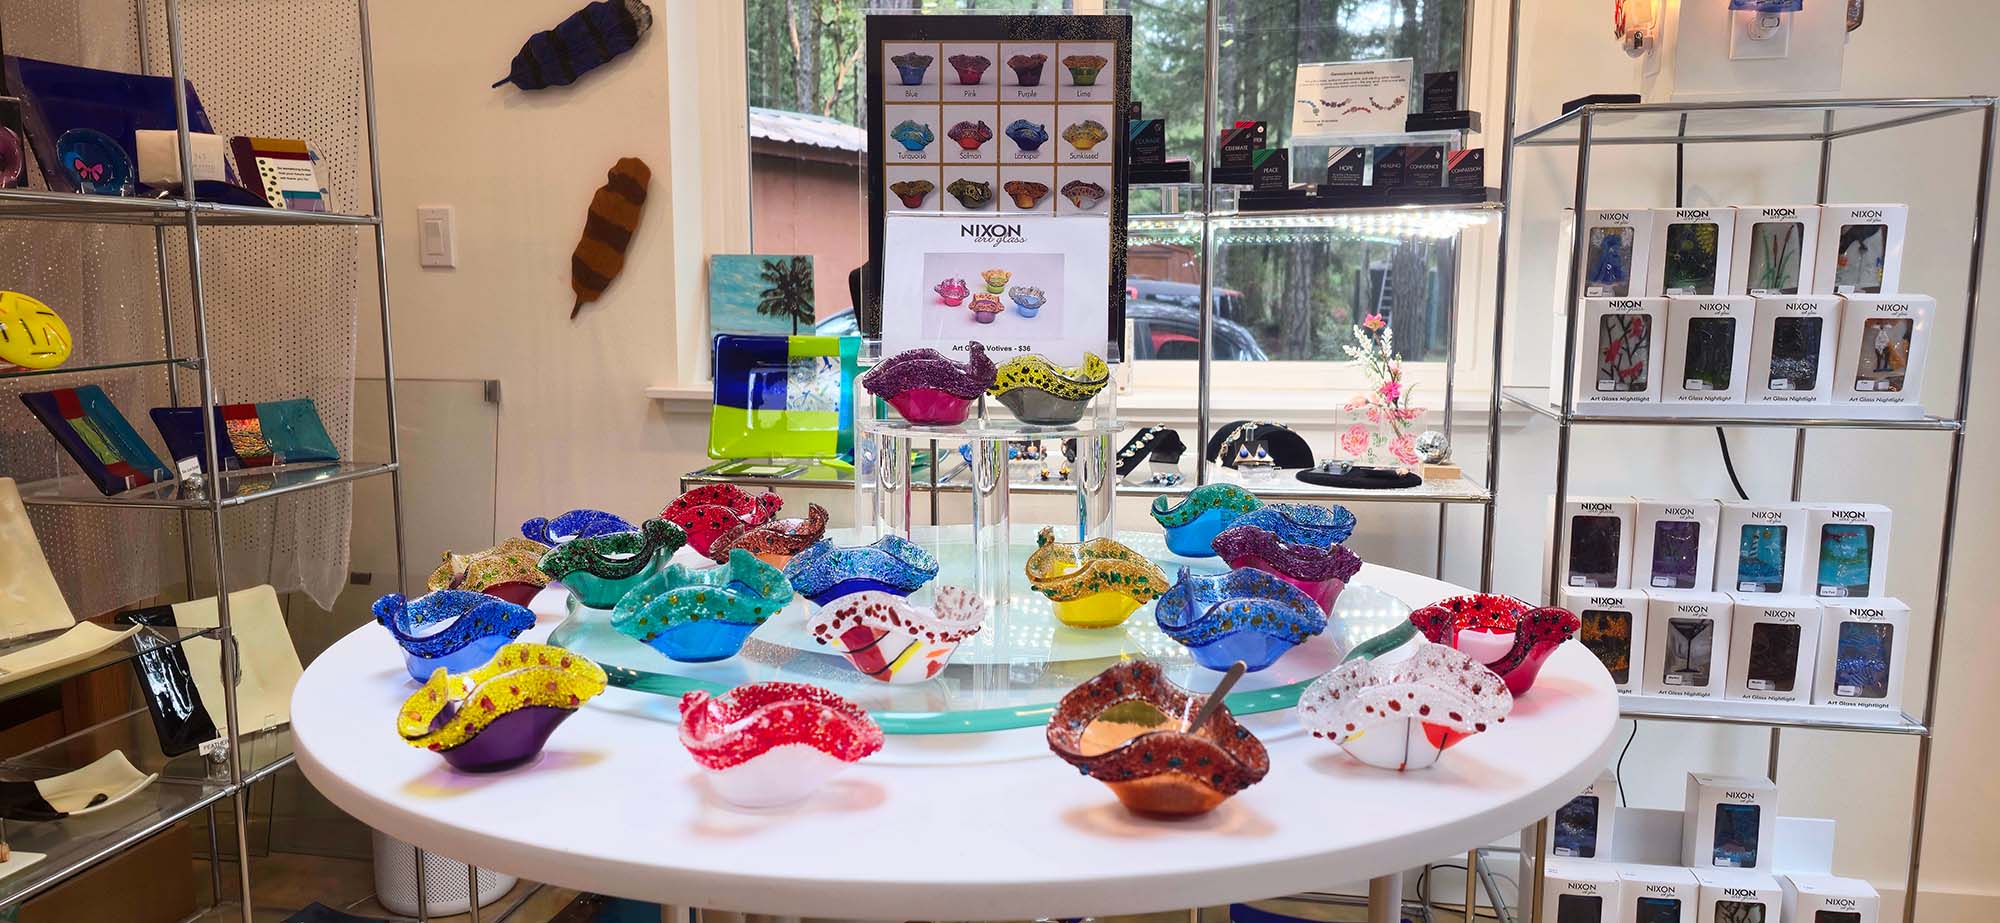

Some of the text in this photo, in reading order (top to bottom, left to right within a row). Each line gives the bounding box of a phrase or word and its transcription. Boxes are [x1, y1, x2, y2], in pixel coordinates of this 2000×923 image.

[1015, 152, 1040, 160] Larkspur
[961, 224, 1020, 237] NIXON
[993, 234, 1027, 247] glass
[1646, 885, 1675, 893] NIXON
[1724, 888, 1756, 897] NIXON
